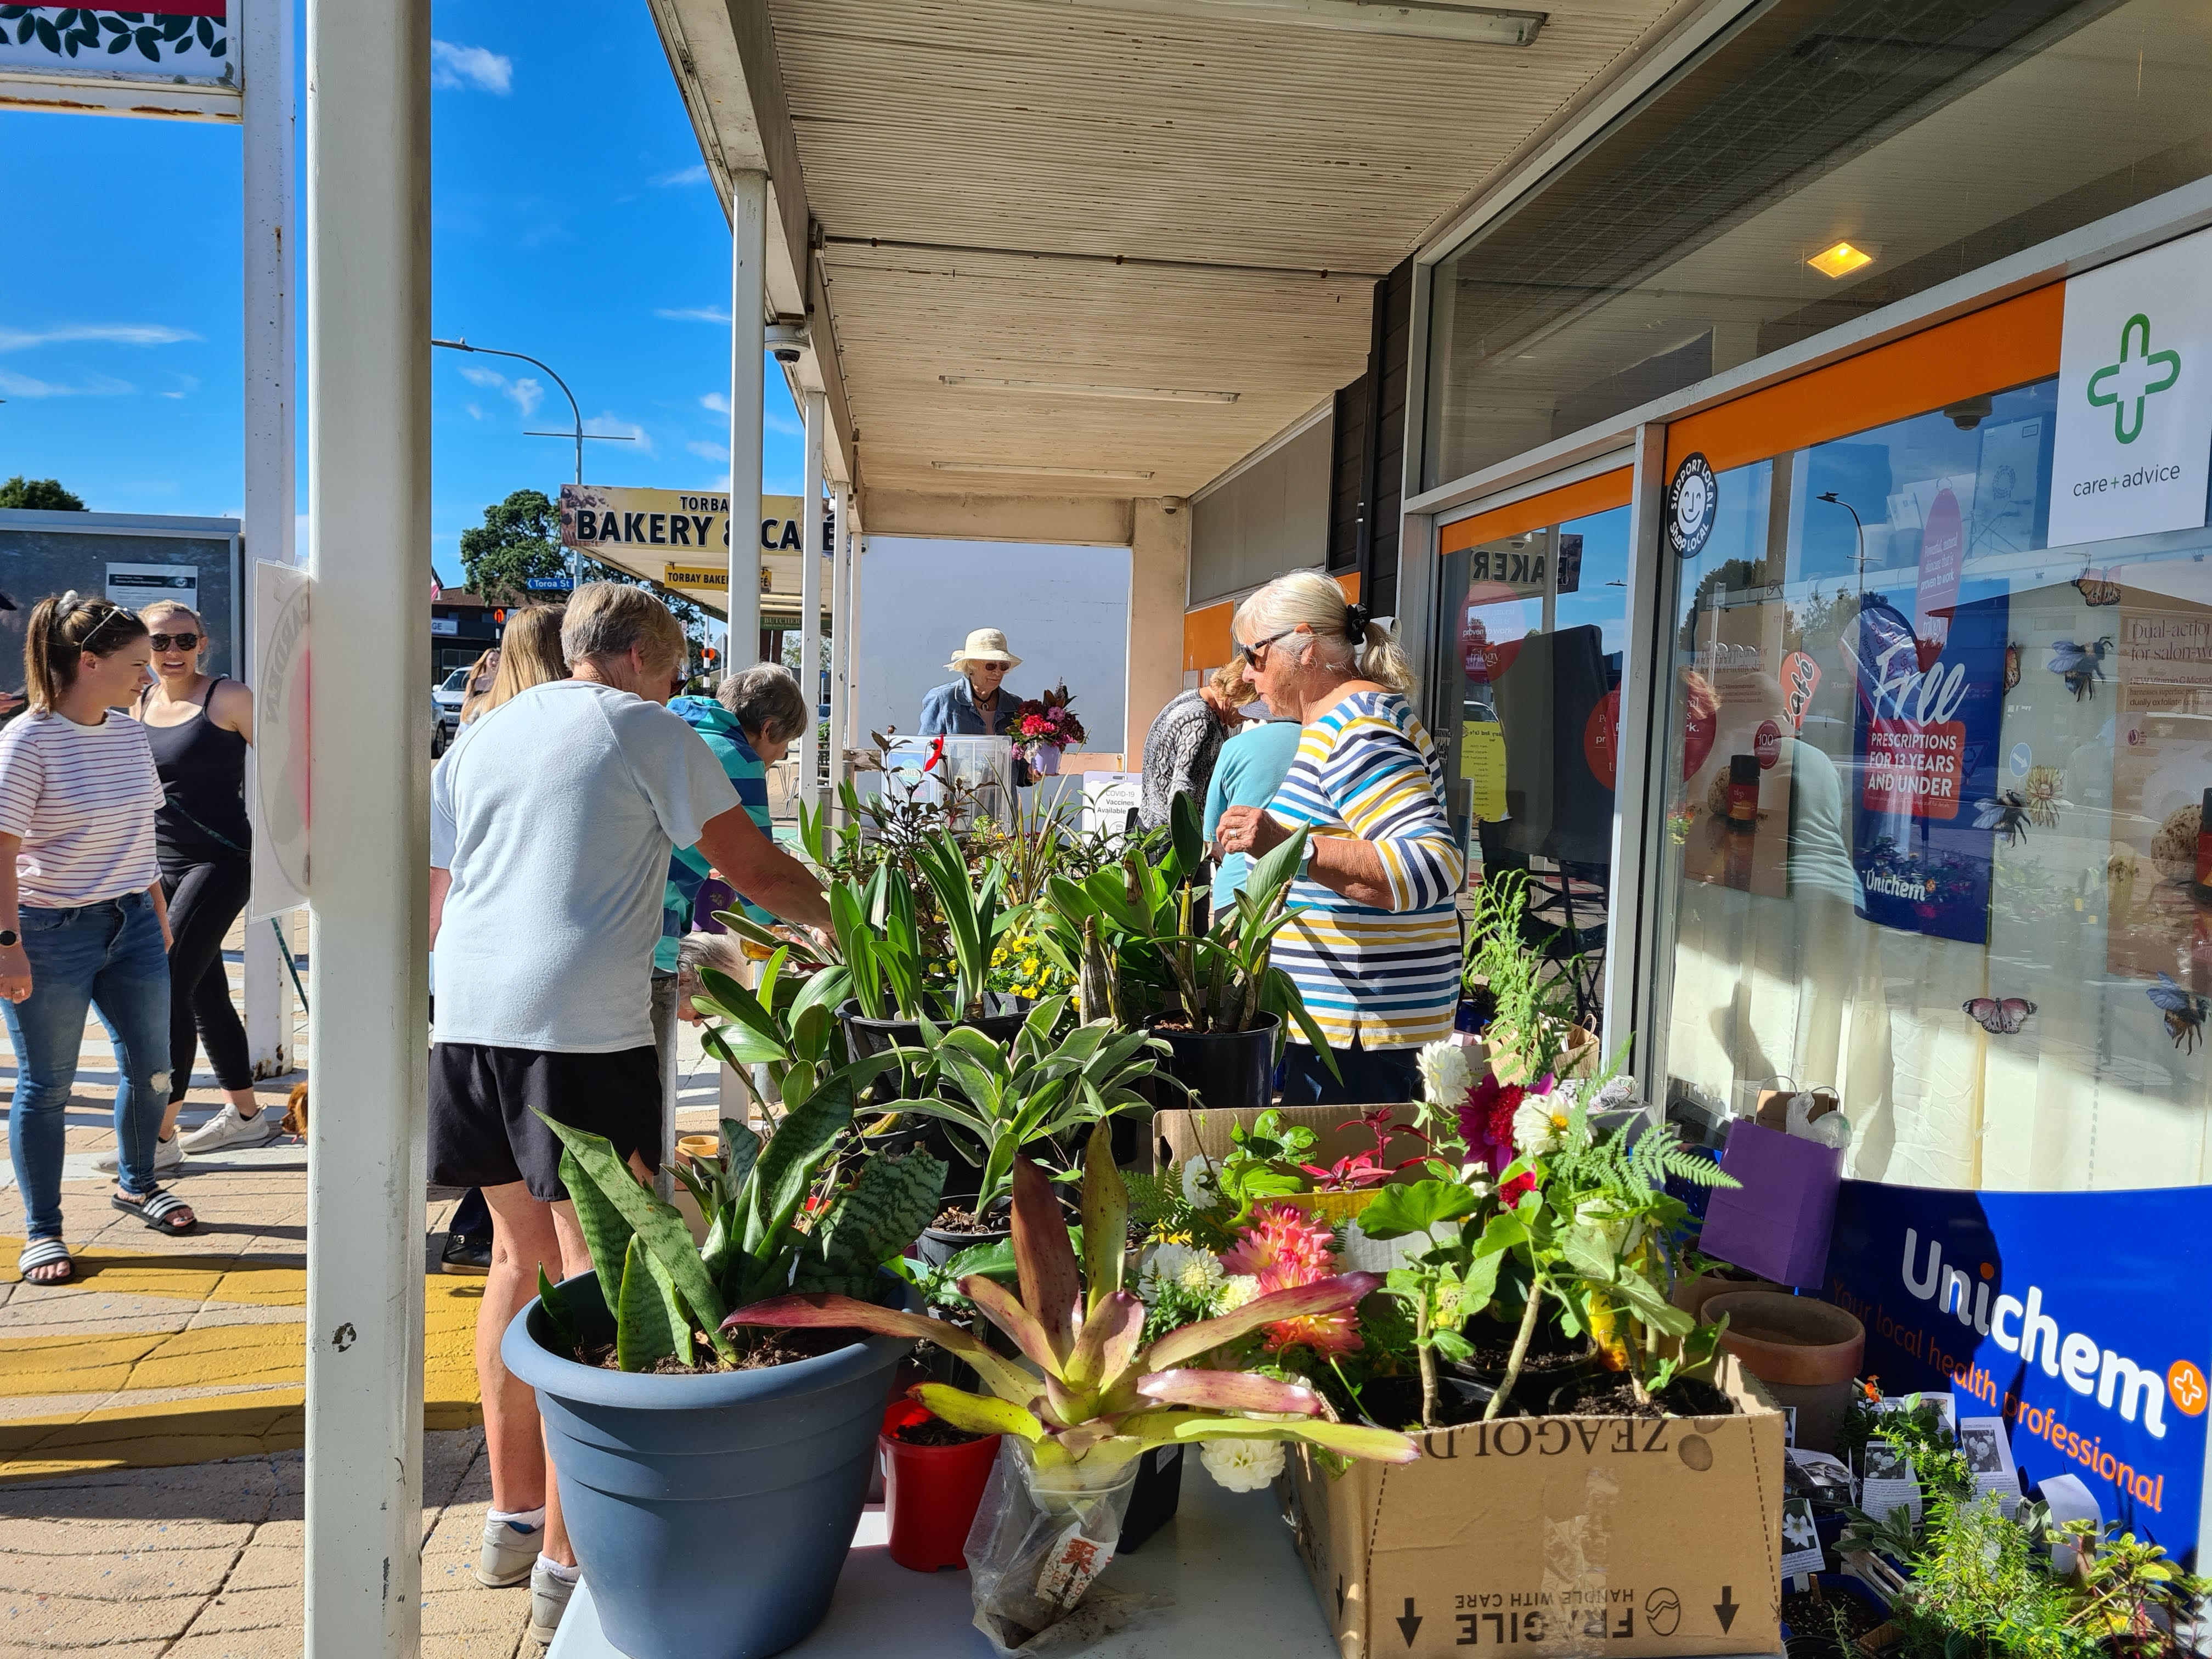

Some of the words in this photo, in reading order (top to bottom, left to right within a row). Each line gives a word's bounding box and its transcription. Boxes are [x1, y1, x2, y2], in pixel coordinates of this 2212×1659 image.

[1671, 459, 1702, 510] SUPPORT
[1701, 463, 1714, 511] LOCAL
[680, 496, 729, 511] TORBA
[577, 510, 713, 546] BAKERY
[761, 514, 834, 551] CAÉ
[1687, 523, 1709, 551] LOCAL
[534, 579, 557, 588] Toroa
[560, 579, 569, 588] St
[668, 572, 701, 583] TORBAY
[704, 574, 729, 585] BAKE
[1921, 578, 1937, 593] proven
[1463, 628, 1483, 638] proven
[1872, 635, 1971, 728] Free
[2130, 699, 2151, 708] dually
[1871, 732, 1957, 751] PRESCRIPTIONS
[1870, 751, 1892, 767] FOR
[1894, 753, 1907, 769] 13
[1908, 753, 1954, 774] YEARS
[1868, 775, 1893, 792] AND
[1897, 776, 1952, 797] UNDER
[1866, 869, 1925, 901] Unichem
[1903, 1228, 2166, 1438] Unichem
[1832, 1278, 1872, 1321] Your
[1876, 1304, 1922, 1359] local
[1929, 1337, 1997, 1408] health
[2002, 1390, 2164, 1513] professional
[1424, 1419, 1668, 1459] ZEAGOLD
[1455, 1595, 1503, 1609] CARE
[1510, 1592, 1554, 1606] WITH
[1562, 1589, 1634, 1605] HANDLE
